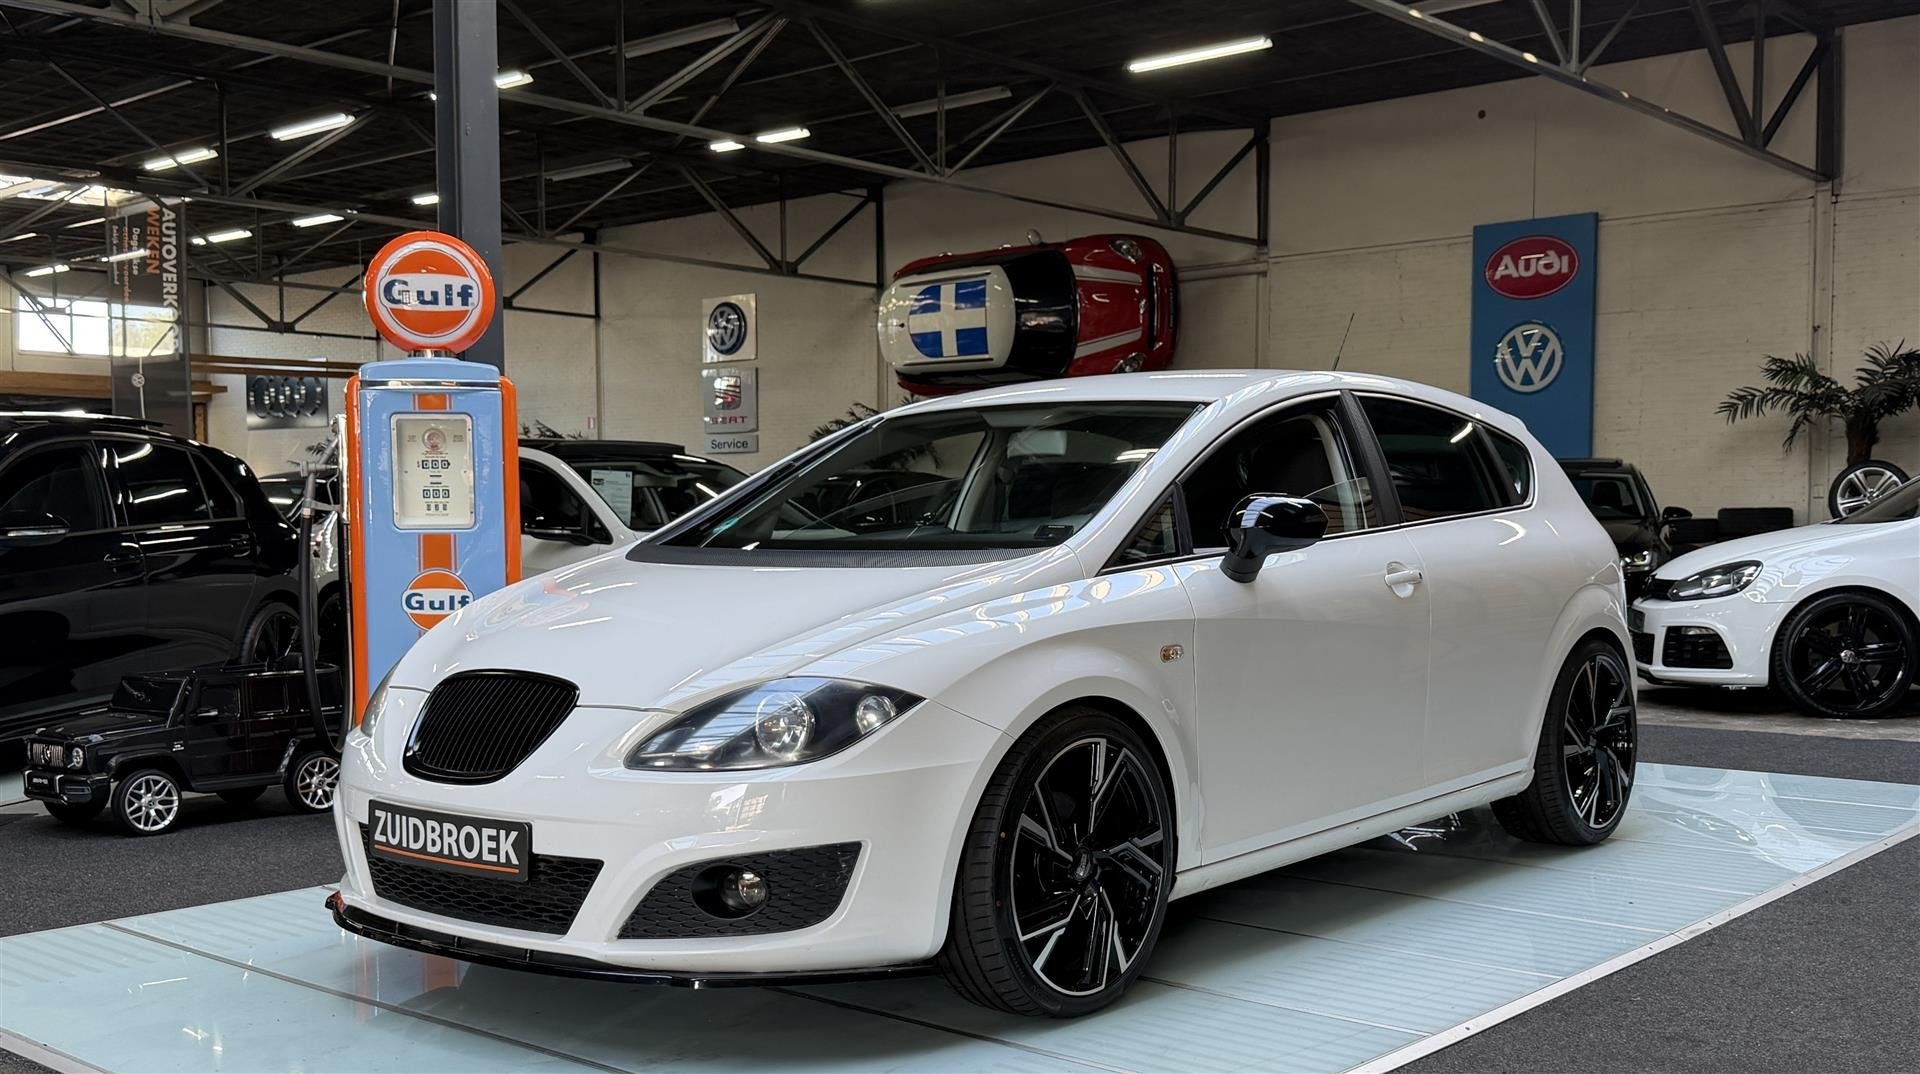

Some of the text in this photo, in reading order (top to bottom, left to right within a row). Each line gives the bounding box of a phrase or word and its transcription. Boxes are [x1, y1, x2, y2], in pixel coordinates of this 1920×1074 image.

[130, 227, 141, 276] Dagekse
[145, 207, 161, 276] WEKEN
[161, 207, 181, 358] AUTOVERK
[383, 278, 474, 307] Gulf
[710, 415, 748, 425] SEAT
[711, 439, 749, 450] Service
[405, 592, 470, 611] Gulf
[374, 809, 520, 865] ZUIDBROEK
